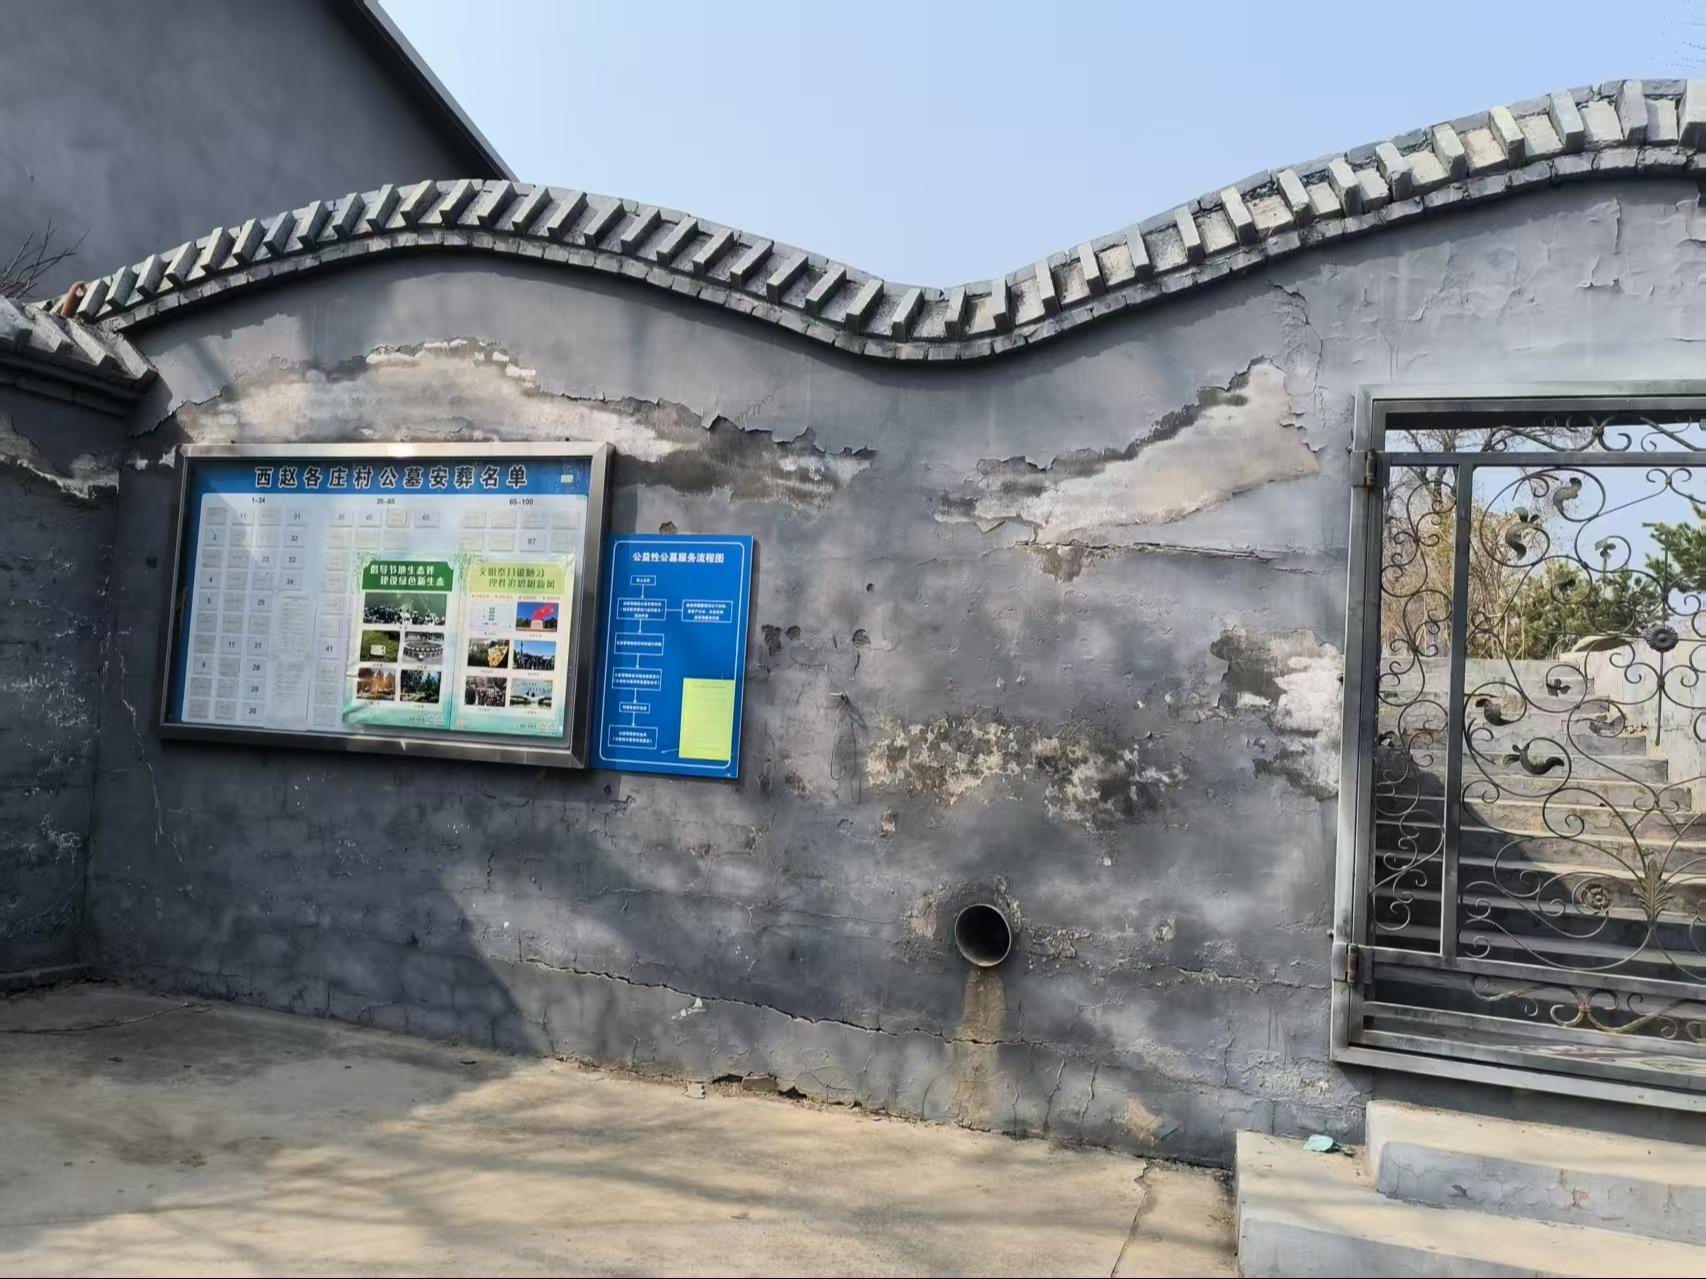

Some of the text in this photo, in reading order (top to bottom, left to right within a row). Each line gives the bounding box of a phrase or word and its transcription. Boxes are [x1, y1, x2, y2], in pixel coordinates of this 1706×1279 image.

[255, 464, 527, 489] 西赵各庄村公墓安葬名单
[632, 551, 725, 564] 公益性公墓服务流程图
